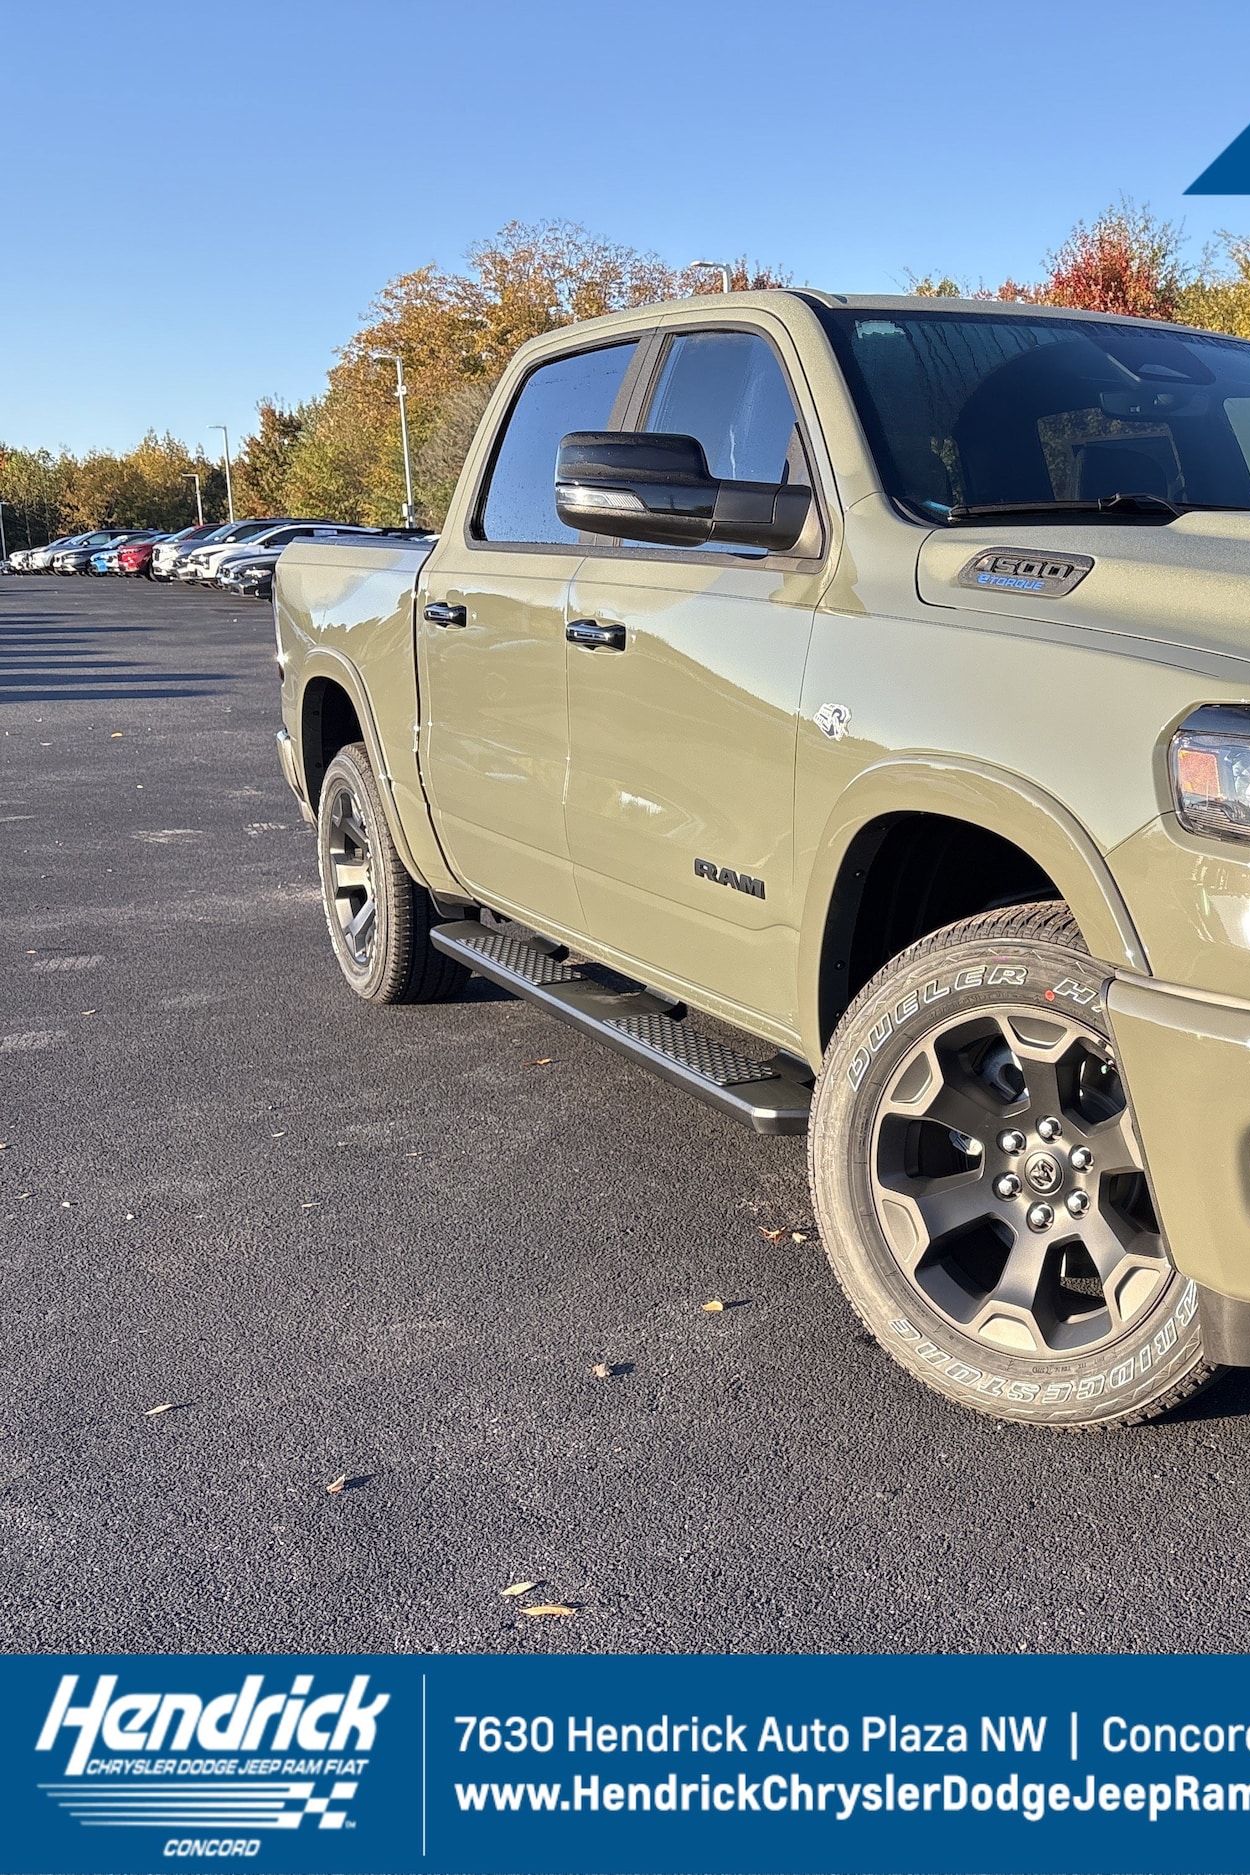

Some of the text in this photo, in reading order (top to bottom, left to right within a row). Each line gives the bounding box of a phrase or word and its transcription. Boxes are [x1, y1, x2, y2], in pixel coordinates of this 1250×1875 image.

[975, 556, 1072, 579] 1500
[977, 573, 1045, 591] eTORQUE
[694, 857, 766, 900] RAM
[847, 965, 1029, 1093] DUELER
[889, 1279, 1200, 1405] BRIDGESTONE
